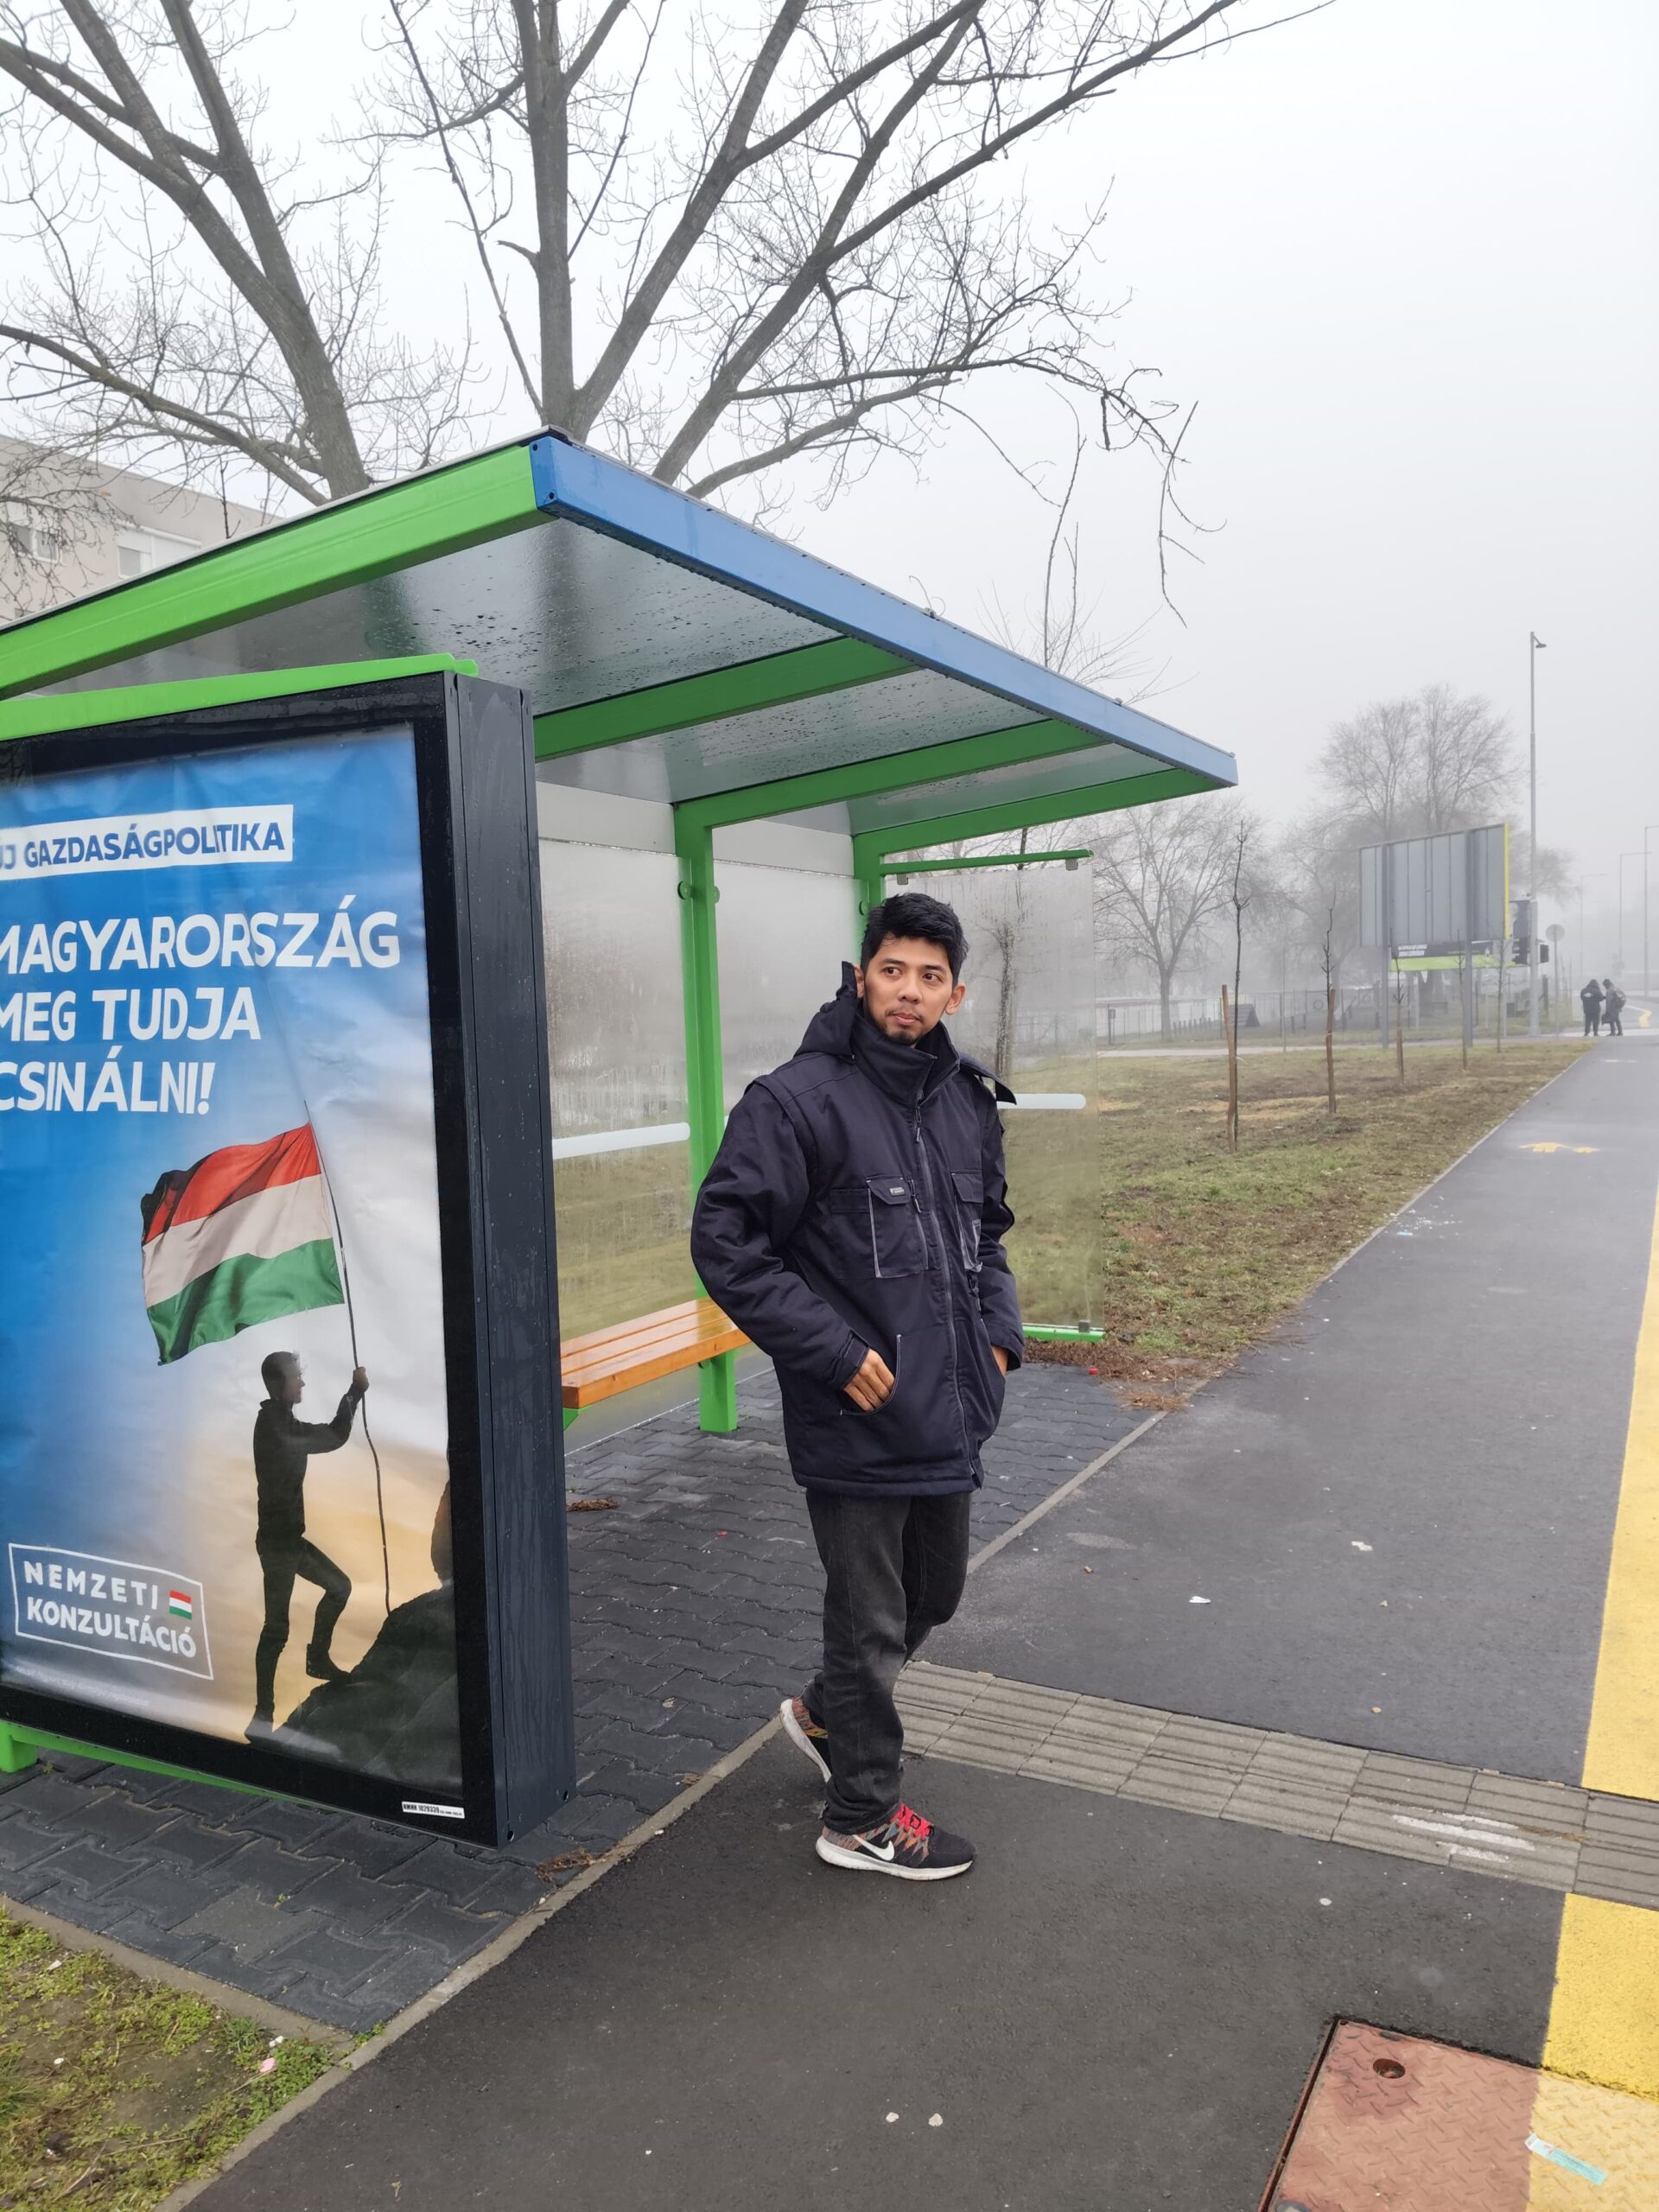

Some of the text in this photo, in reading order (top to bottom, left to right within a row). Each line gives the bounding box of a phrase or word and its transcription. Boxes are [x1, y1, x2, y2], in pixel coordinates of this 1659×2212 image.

[0, 822, 285, 870] J GAZDASÁGPOLITIKA
[0, 987, 262, 1041] MEG TUDJA
[0, 1046, 216, 1115] CSINÁLNI!
[23, 1560, 158, 1610] NEMZETI
[27, 1596, 197, 1658] KONZULTÁCIÓ
